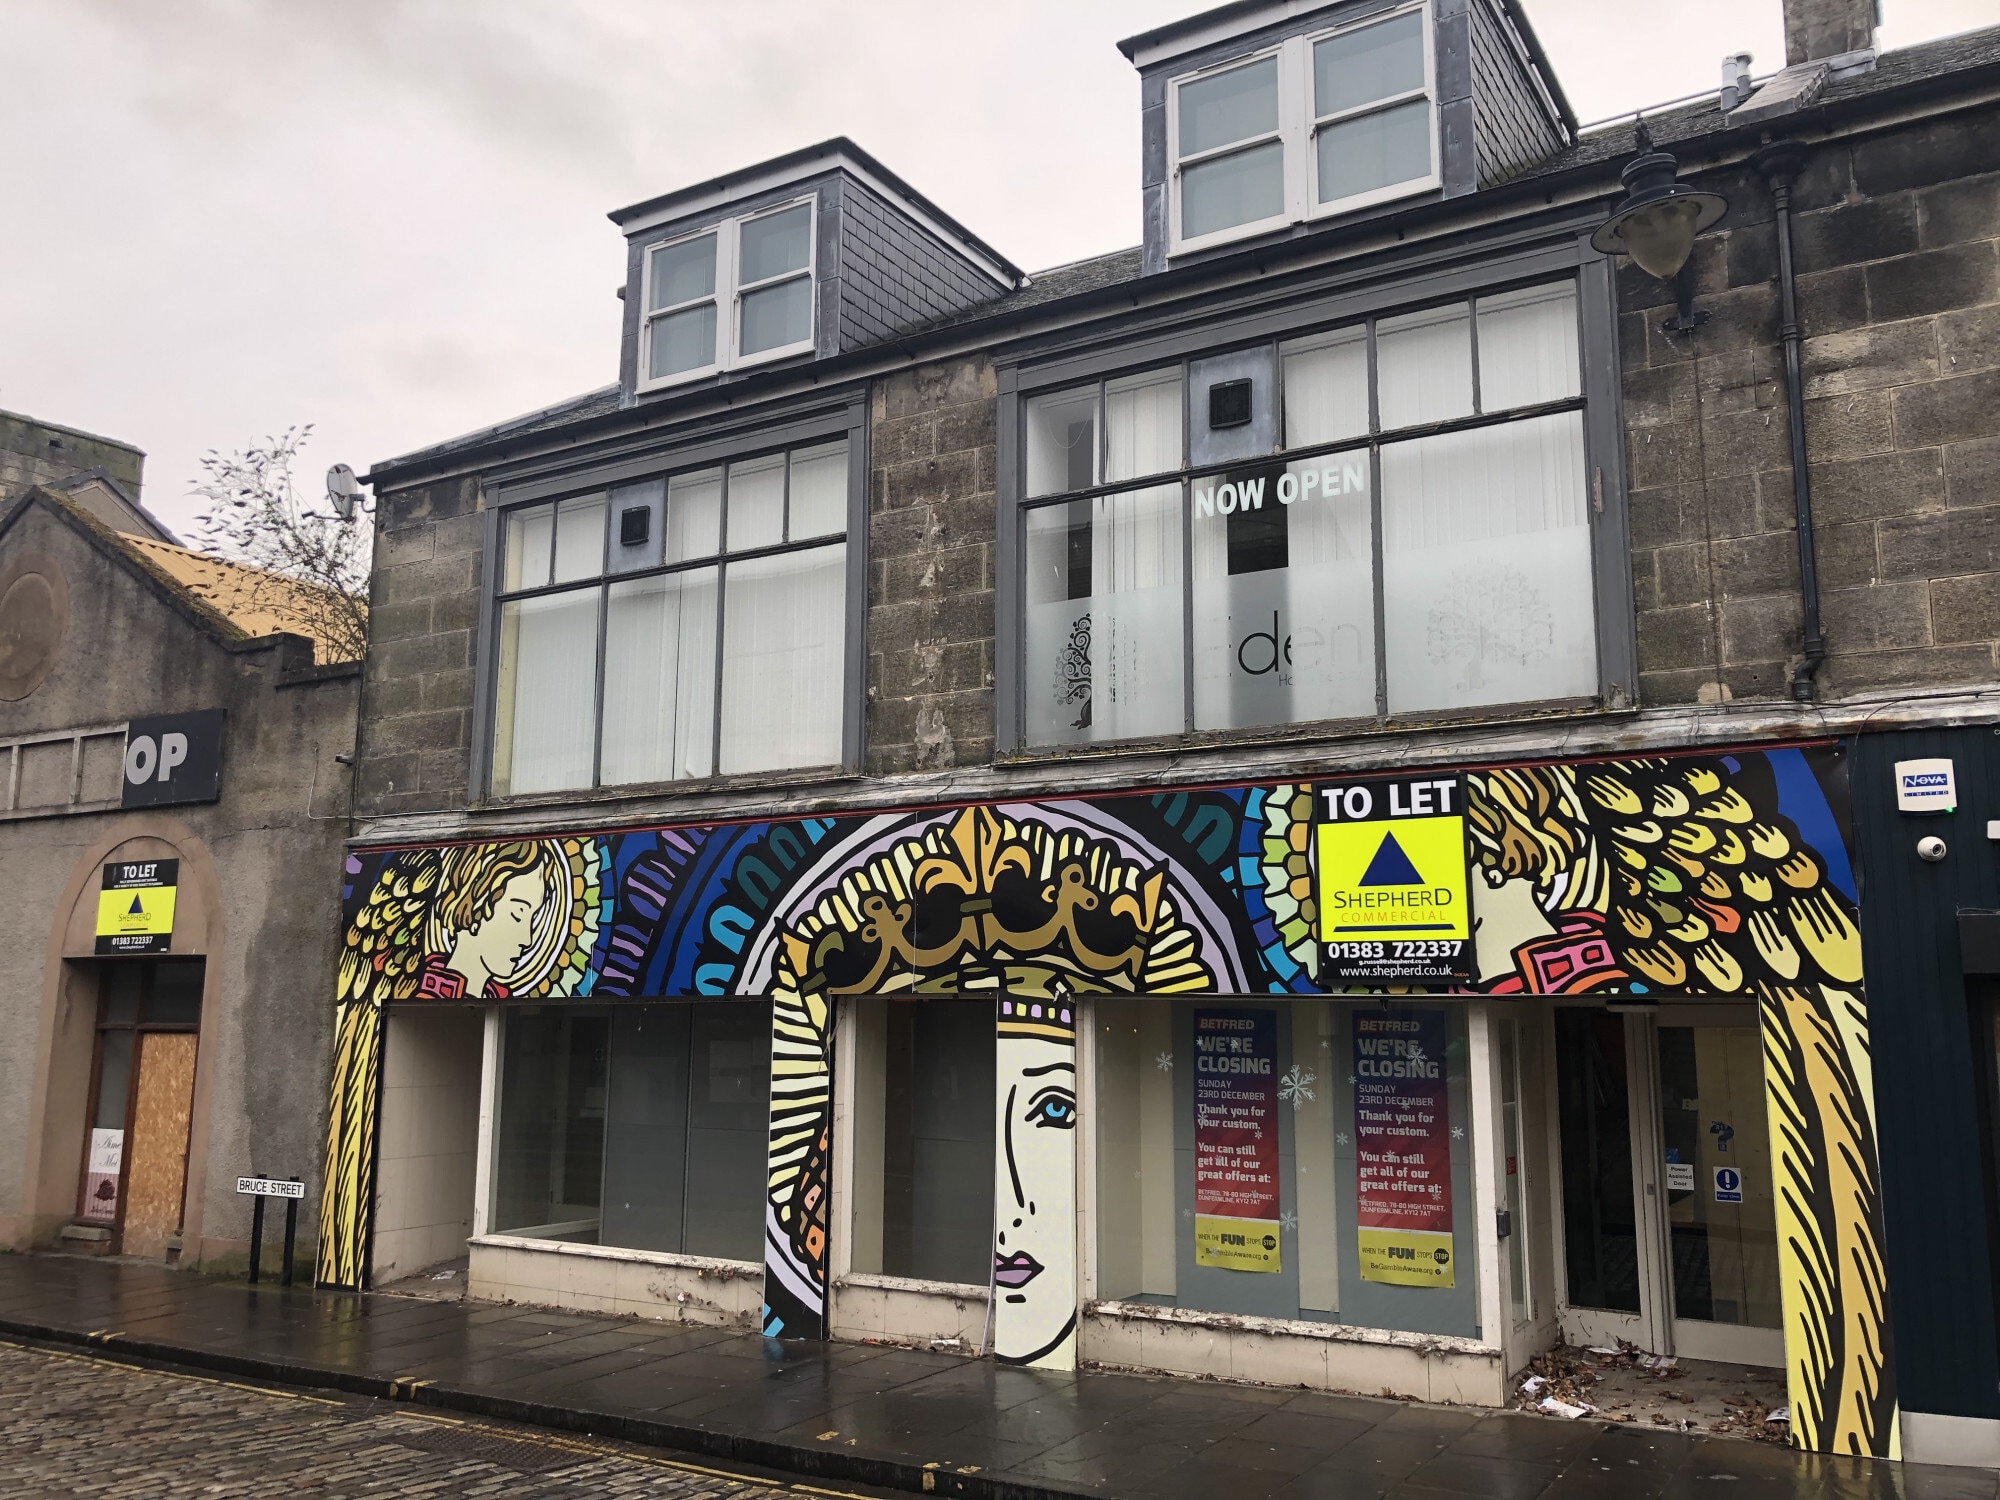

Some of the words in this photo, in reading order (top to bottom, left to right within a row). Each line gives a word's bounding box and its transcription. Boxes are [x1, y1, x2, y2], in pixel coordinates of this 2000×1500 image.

[1195, 477, 1265, 519] NOW
[1277, 463, 1363, 504] OPEN
[126, 733, 188, 784] OP
[1322, 786, 1372, 819] TO
[1390, 780, 1456, 816] LET
[124, 866, 137, 878] TO
[139, 864, 157, 877] LET
[1334, 888, 1452, 908] SHEPHERD
[118, 913, 151, 921] SHEPHERD
[1341, 911, 1446, 923] COMMERCIAL
[131, 936, 153, 944] 722337
[1328, 943, 1384, 959] 01383
[1392, 941, 1462, 957] 722337
[1340, 965, 1452, 978] www.shepherd.co.uk
[1201, 1019, 1254, 1029] BETFRED
[1360, 1021, 1420, 1031] BETFRED
[1199, 1036, 1253, 1053] WE'RE
[1358, 1039, 1419, 1056] WE'RE
[1198, 1056, 1270, 1074] CLOSING
[1359, 1060, 1439, 1078] CLOSING
[1198, 1079, 1231, 1088] SUNDAY
[1359, 1084, 1396, 1093] SUNDAY
[1198, 1090, 1219, 1098] 23RD
[1221, 1091, 1265, 1100] DECEMBER
[1359, 1096, 1382, 1104] 23RD
[1385, 1097, 1433, 1106] DECEMBER
[1198, 1104, 1227, 1114] Thank
[1231, 1108, 1248, 1117] you
[1251, 1107, 1265, 1116] for
[1359, 1110, 1392, 1121] Thank
[1396, 1114, 1415, 1124] you
[1418, 1112, 1434, 1123] for
[1198, 1119, 1219, 1128] your
[1223, 1120, 1260, 1129] custom.
[1359, 1126, 1384, 1136] your
[1387, 1127, 1429, 1137] custom.
[1199, 1142, 1215, 1152] You
[1236, 1145, 1256, 1155] still
[1198, 1157, 1213, 1167] get
[1216, 1157, 1228, 1166] all
[1231, 1158, 1241, 1167] of
[1360, 1151, 1379, 1161] You
[1382, 1155, 1400, 1163] can
[1403, 1154, 1425, 1164] still
[1198, 1171, 1222, 1181] great
[1225, 1171, 1255, 1181] offers
[1258, 1174, 1270, 1183] at:
[1360, 1166, 1377, 1178] get
[1380, 1166, 1394, 1177] all
[1397, 1167, 1408, 1177] of
[240, 1180, 267, 1192] BRUCE
[271, 1183, 302, 1195] STREET
[1361, 1181, 1388, 1192] great
[1391, 1181, 1425, 1192] offers
[1428, 1184, 1442, 1193] at:
[1221, 1234, 1245, 1246] FUN
[1388, 1247, 1415, 1260] FUN
[1371, 1263, 1433, 1275] BeGambleAware.org
